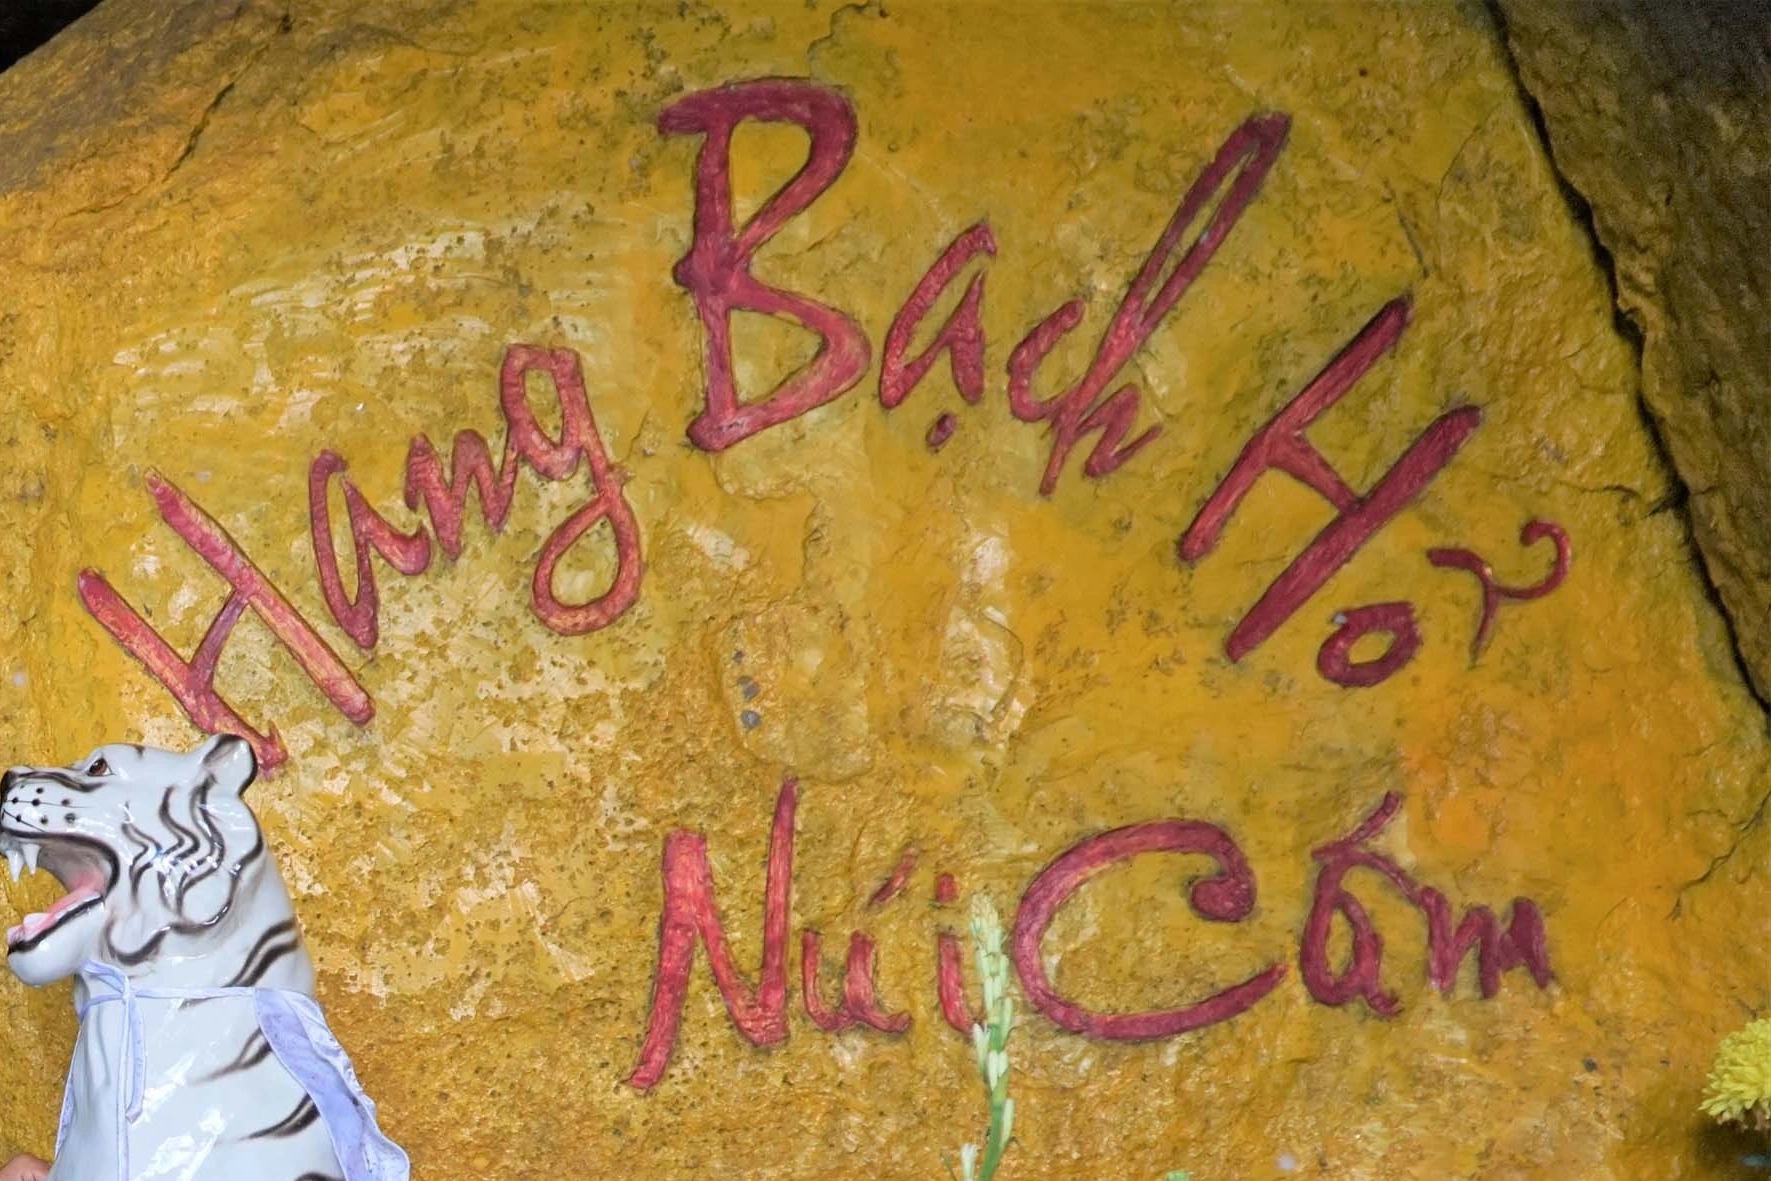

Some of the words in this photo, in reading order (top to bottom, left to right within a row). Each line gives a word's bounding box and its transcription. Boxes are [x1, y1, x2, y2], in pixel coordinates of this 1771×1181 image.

[78, 340, 643, 777] Hang
[656, 75, 1293, 494] Bạch
[1178, 293, 1572, 688] Hổ
[631, 776, 979, 1090] Núi
[1013, 790, 1556, 1042] Cấm
